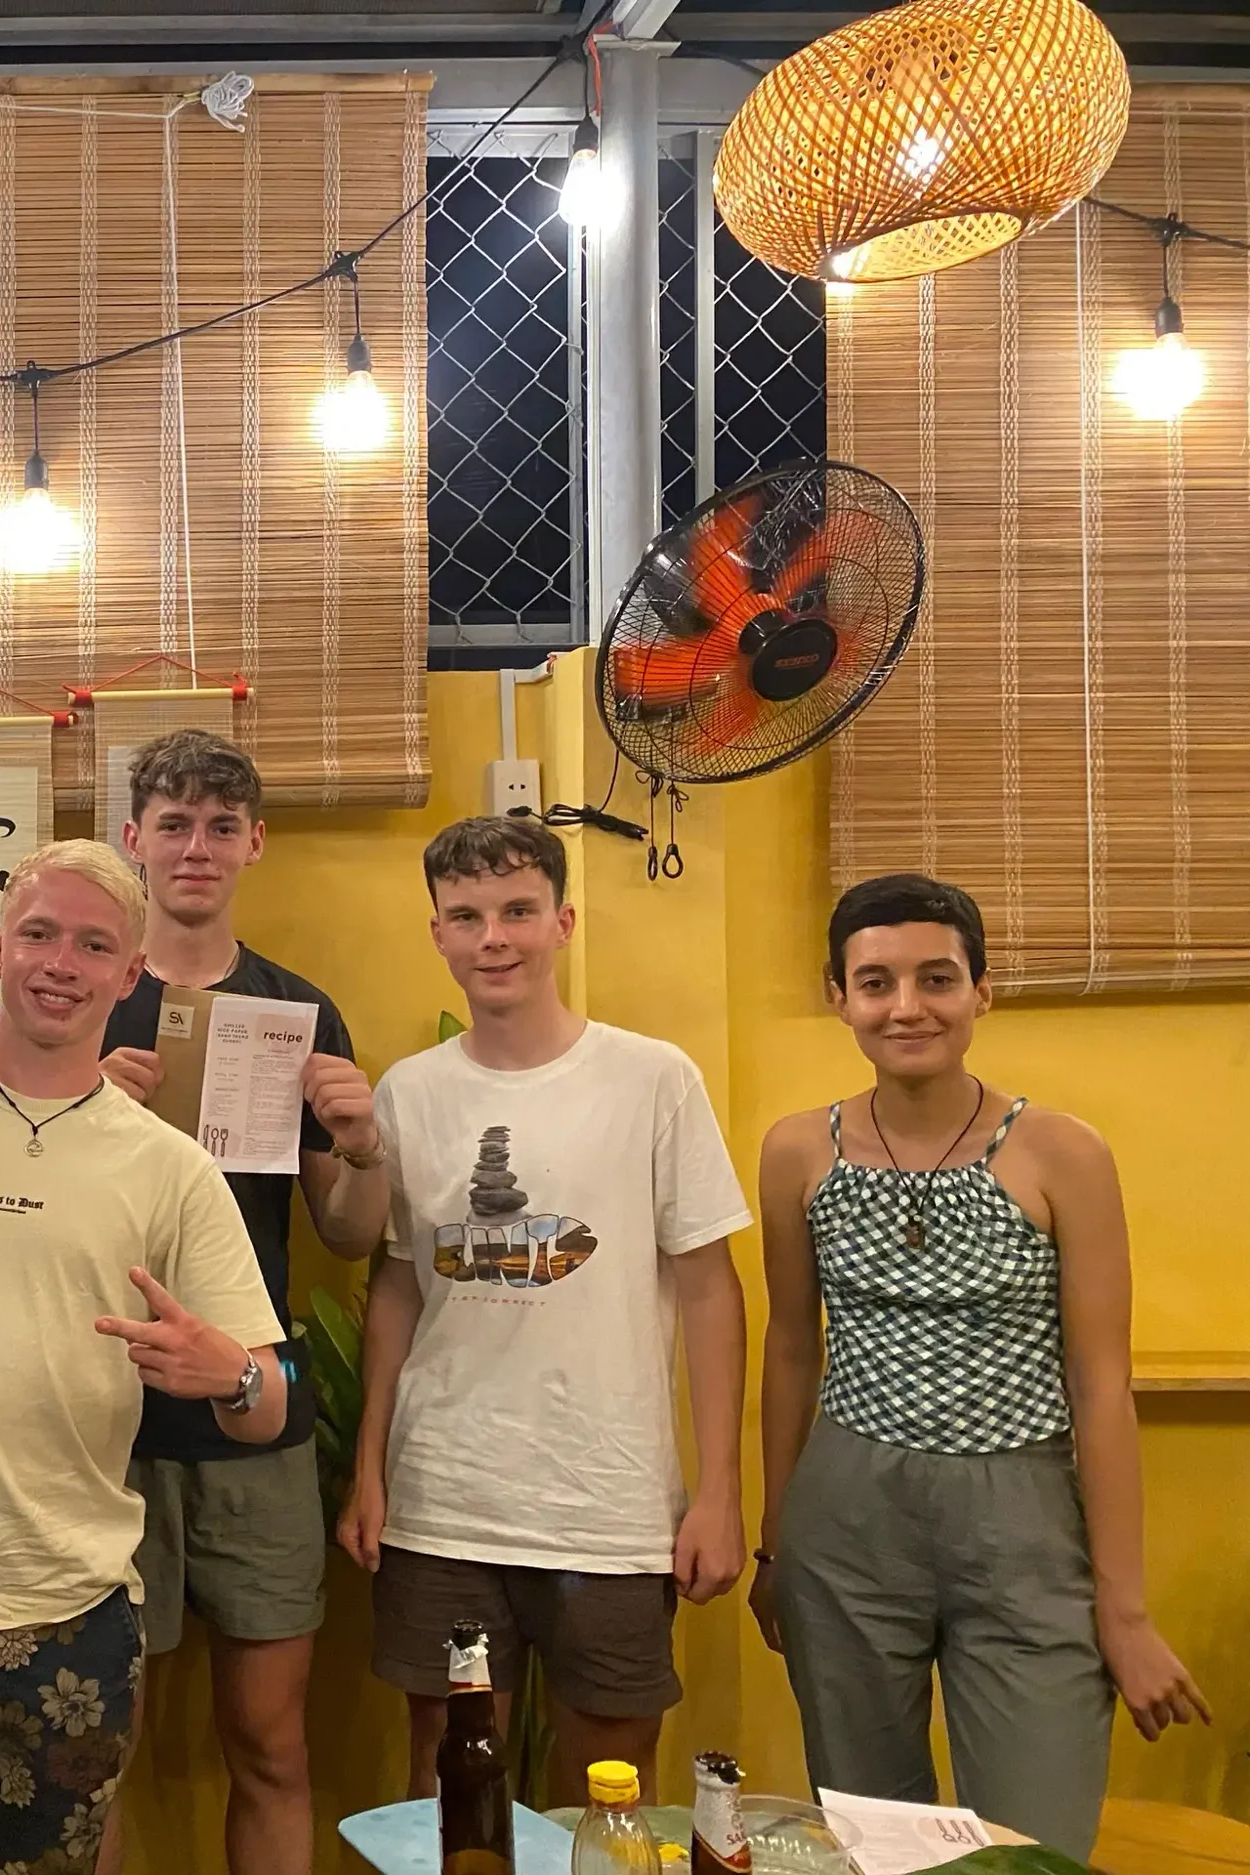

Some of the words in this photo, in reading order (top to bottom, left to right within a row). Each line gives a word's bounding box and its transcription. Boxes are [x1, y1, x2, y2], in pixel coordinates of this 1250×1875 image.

[263, 1031, 303, 1044] recipe
[6, 1197, 16, 1206] to
[18, 1197, 45, 1210] Dust
